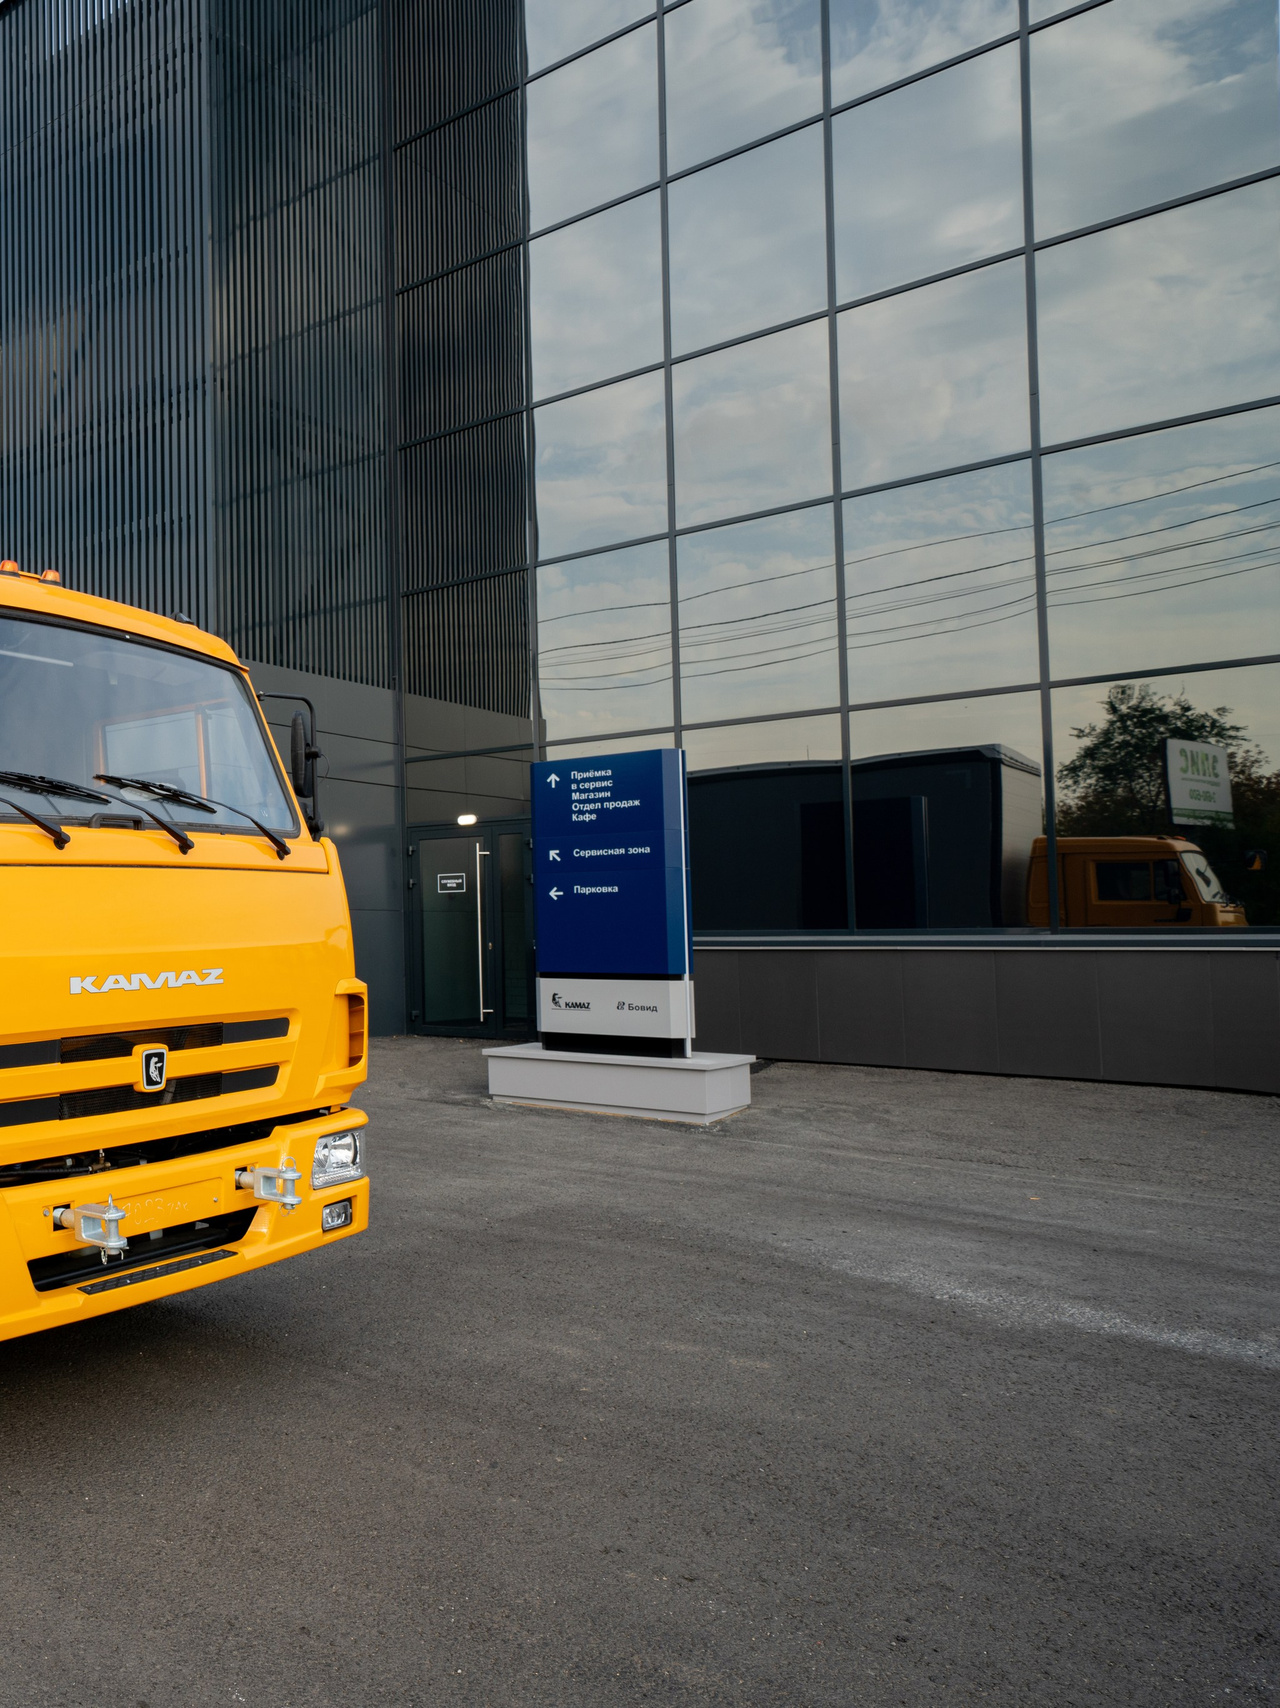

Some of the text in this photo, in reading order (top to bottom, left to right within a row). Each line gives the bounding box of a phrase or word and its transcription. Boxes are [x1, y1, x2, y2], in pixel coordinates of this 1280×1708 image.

[571, 769, 612, 780] Приёмка
[579, 780, 613, 790] сервис
[572, 791, 611, 800] Магазин
[572, 799, 641, 811] Отдел продаж
[572, 812, 597, 822] Кафе
[573, 846, 651, 858] Сервисная зона
[573, 885, 619, 895] Парковка
[69, 967, 224, 995] KAMAZ
[564, 1001, 591, 1010] KAMAZ
[627, 1003, 658, 1013] Бовид
